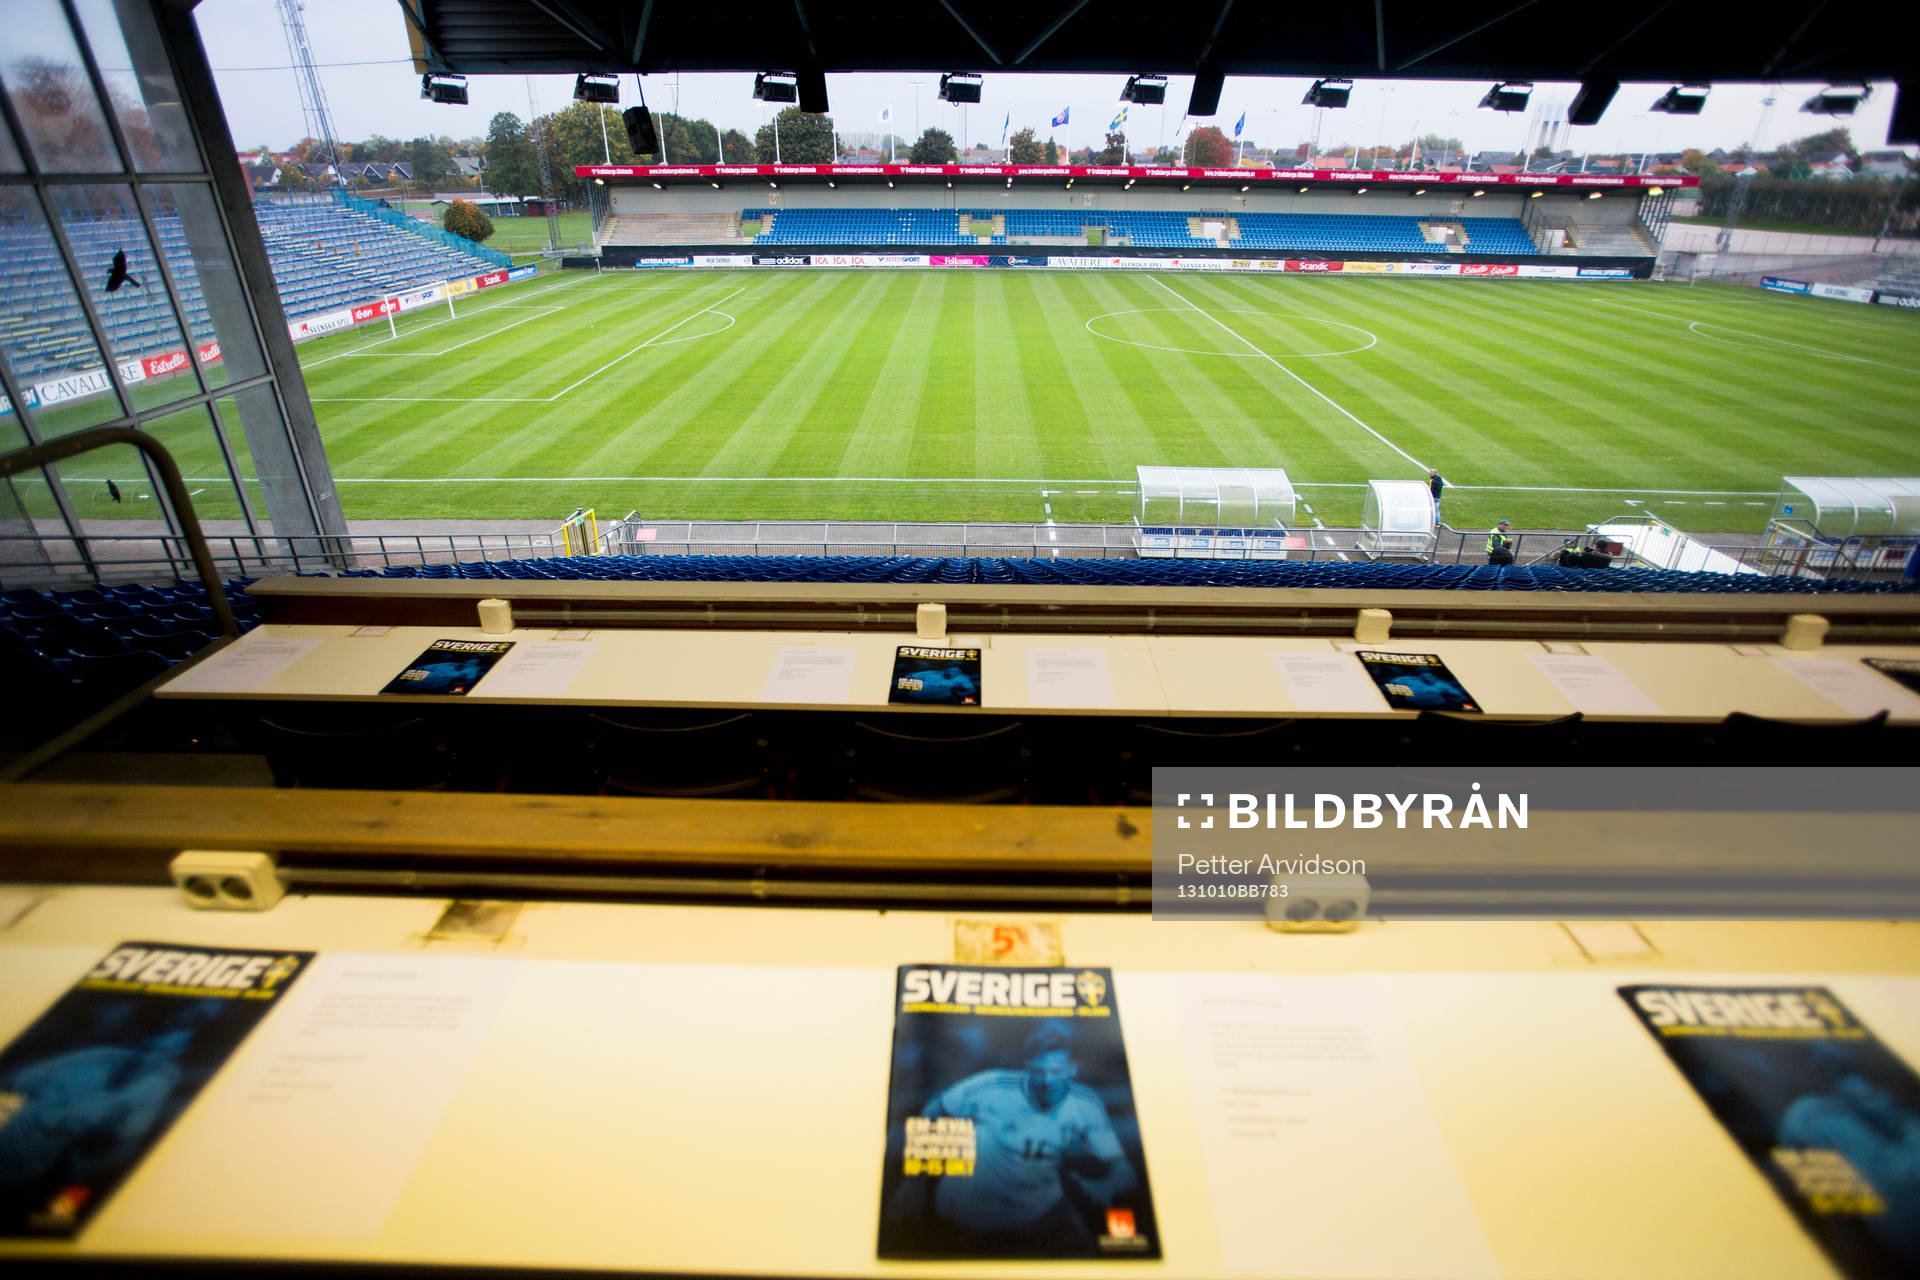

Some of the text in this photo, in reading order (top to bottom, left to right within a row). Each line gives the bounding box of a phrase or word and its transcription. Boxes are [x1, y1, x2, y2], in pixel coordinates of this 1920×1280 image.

[776, 256, 804, 265] adidas
[814, 256, 828, 265] ICA
[833, 256, 847, 265] ICA
[851, 256, 865, 265] ICA
[1049, 257, 1102, 266] CAVALIERE
[1299, 262, 1329, 271] Scandic
[150, 351, 186, 376] Estrella
[41, 365, 140, 402] CAVALIRE
[431, 640, 496, 652] SVERIGE
[899, 646, 966, 659] SVERIGE
[1360, 651, 1428, 664] SVERIGE
[88, 948, 273, 988] SVERIGE
[902, 969, 1077, 1008] SVERIGE
[1635, 989, 1823, 1028] SVERIGE
